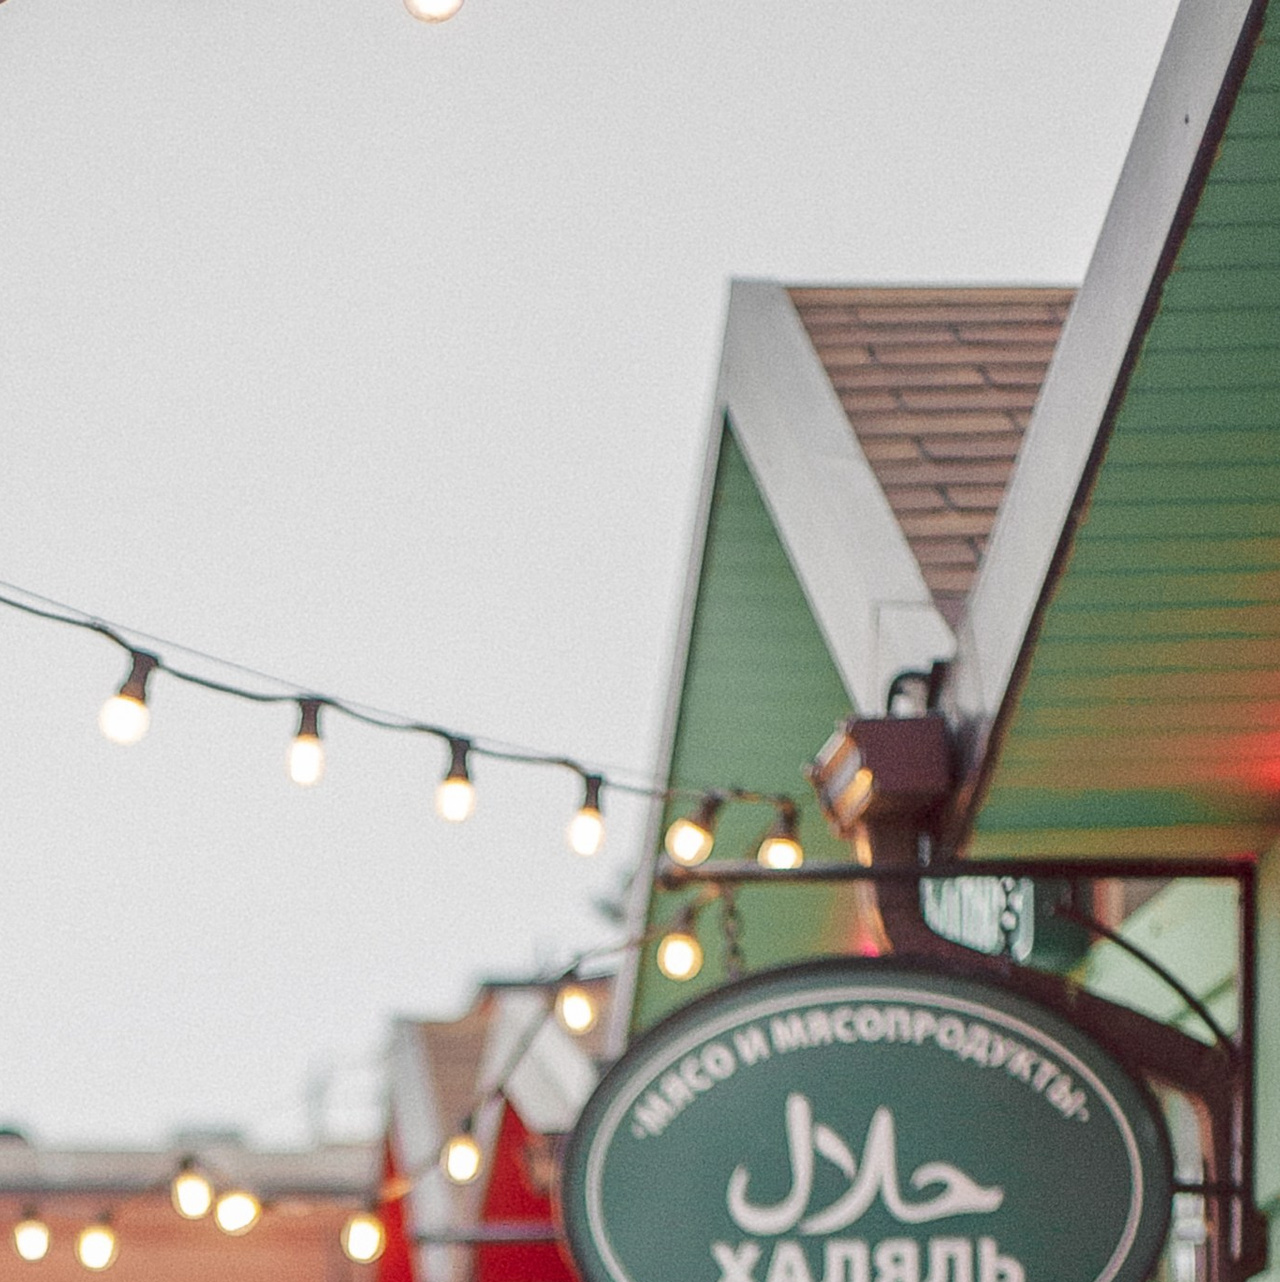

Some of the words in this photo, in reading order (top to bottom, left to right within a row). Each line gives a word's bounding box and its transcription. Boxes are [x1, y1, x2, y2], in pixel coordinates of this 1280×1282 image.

[634, 1039, 736, 1137] МЯСО
[733, 1025, 771, 1066] И
[726, 1091, 1004, 1236] حلال
